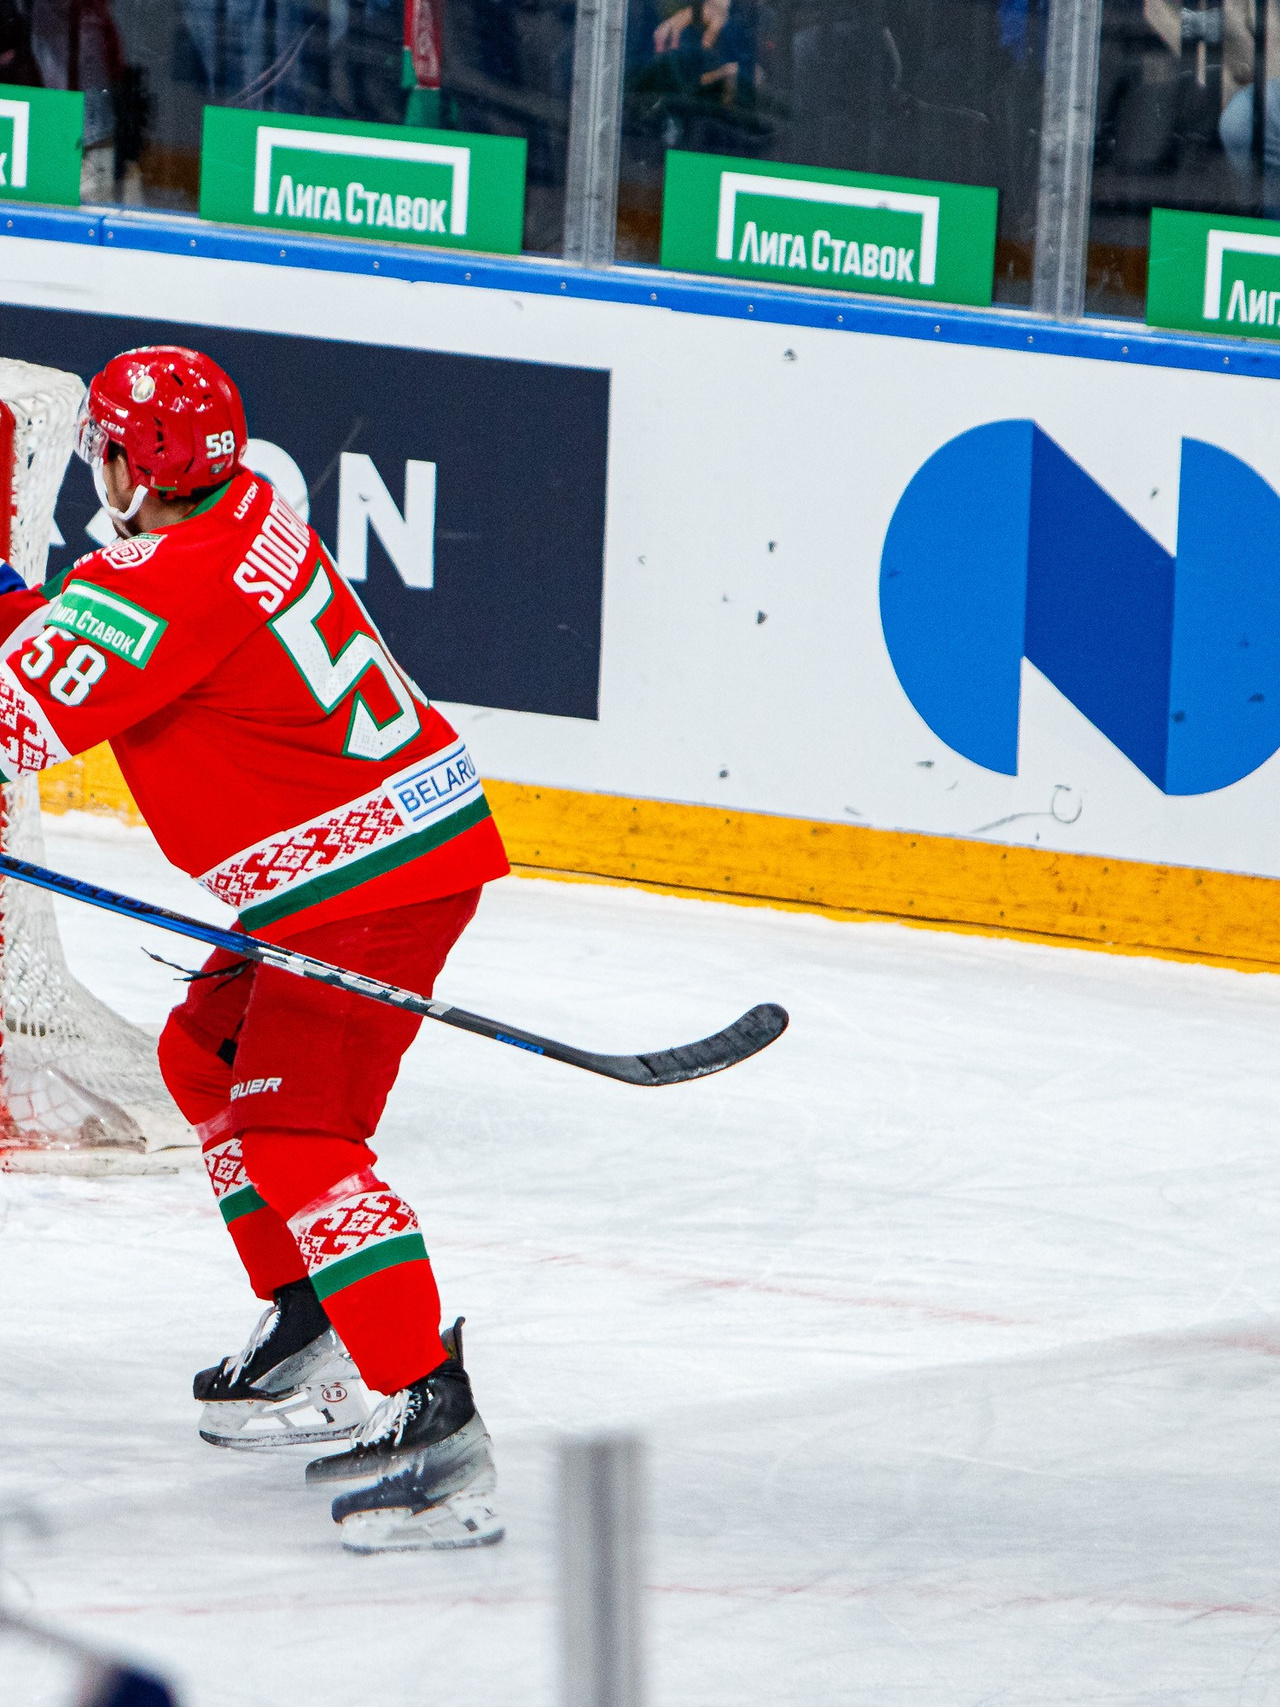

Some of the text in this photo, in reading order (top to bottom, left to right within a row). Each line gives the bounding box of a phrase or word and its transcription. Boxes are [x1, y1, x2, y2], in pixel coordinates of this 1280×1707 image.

[100, 419, 126, 436] CCM
[205, 429, 236, 460] 58
[232, 480, 260, 521] LUTCH
[20, 624, 109, 708] 58
[397, 752, 477, 814] BELARU
